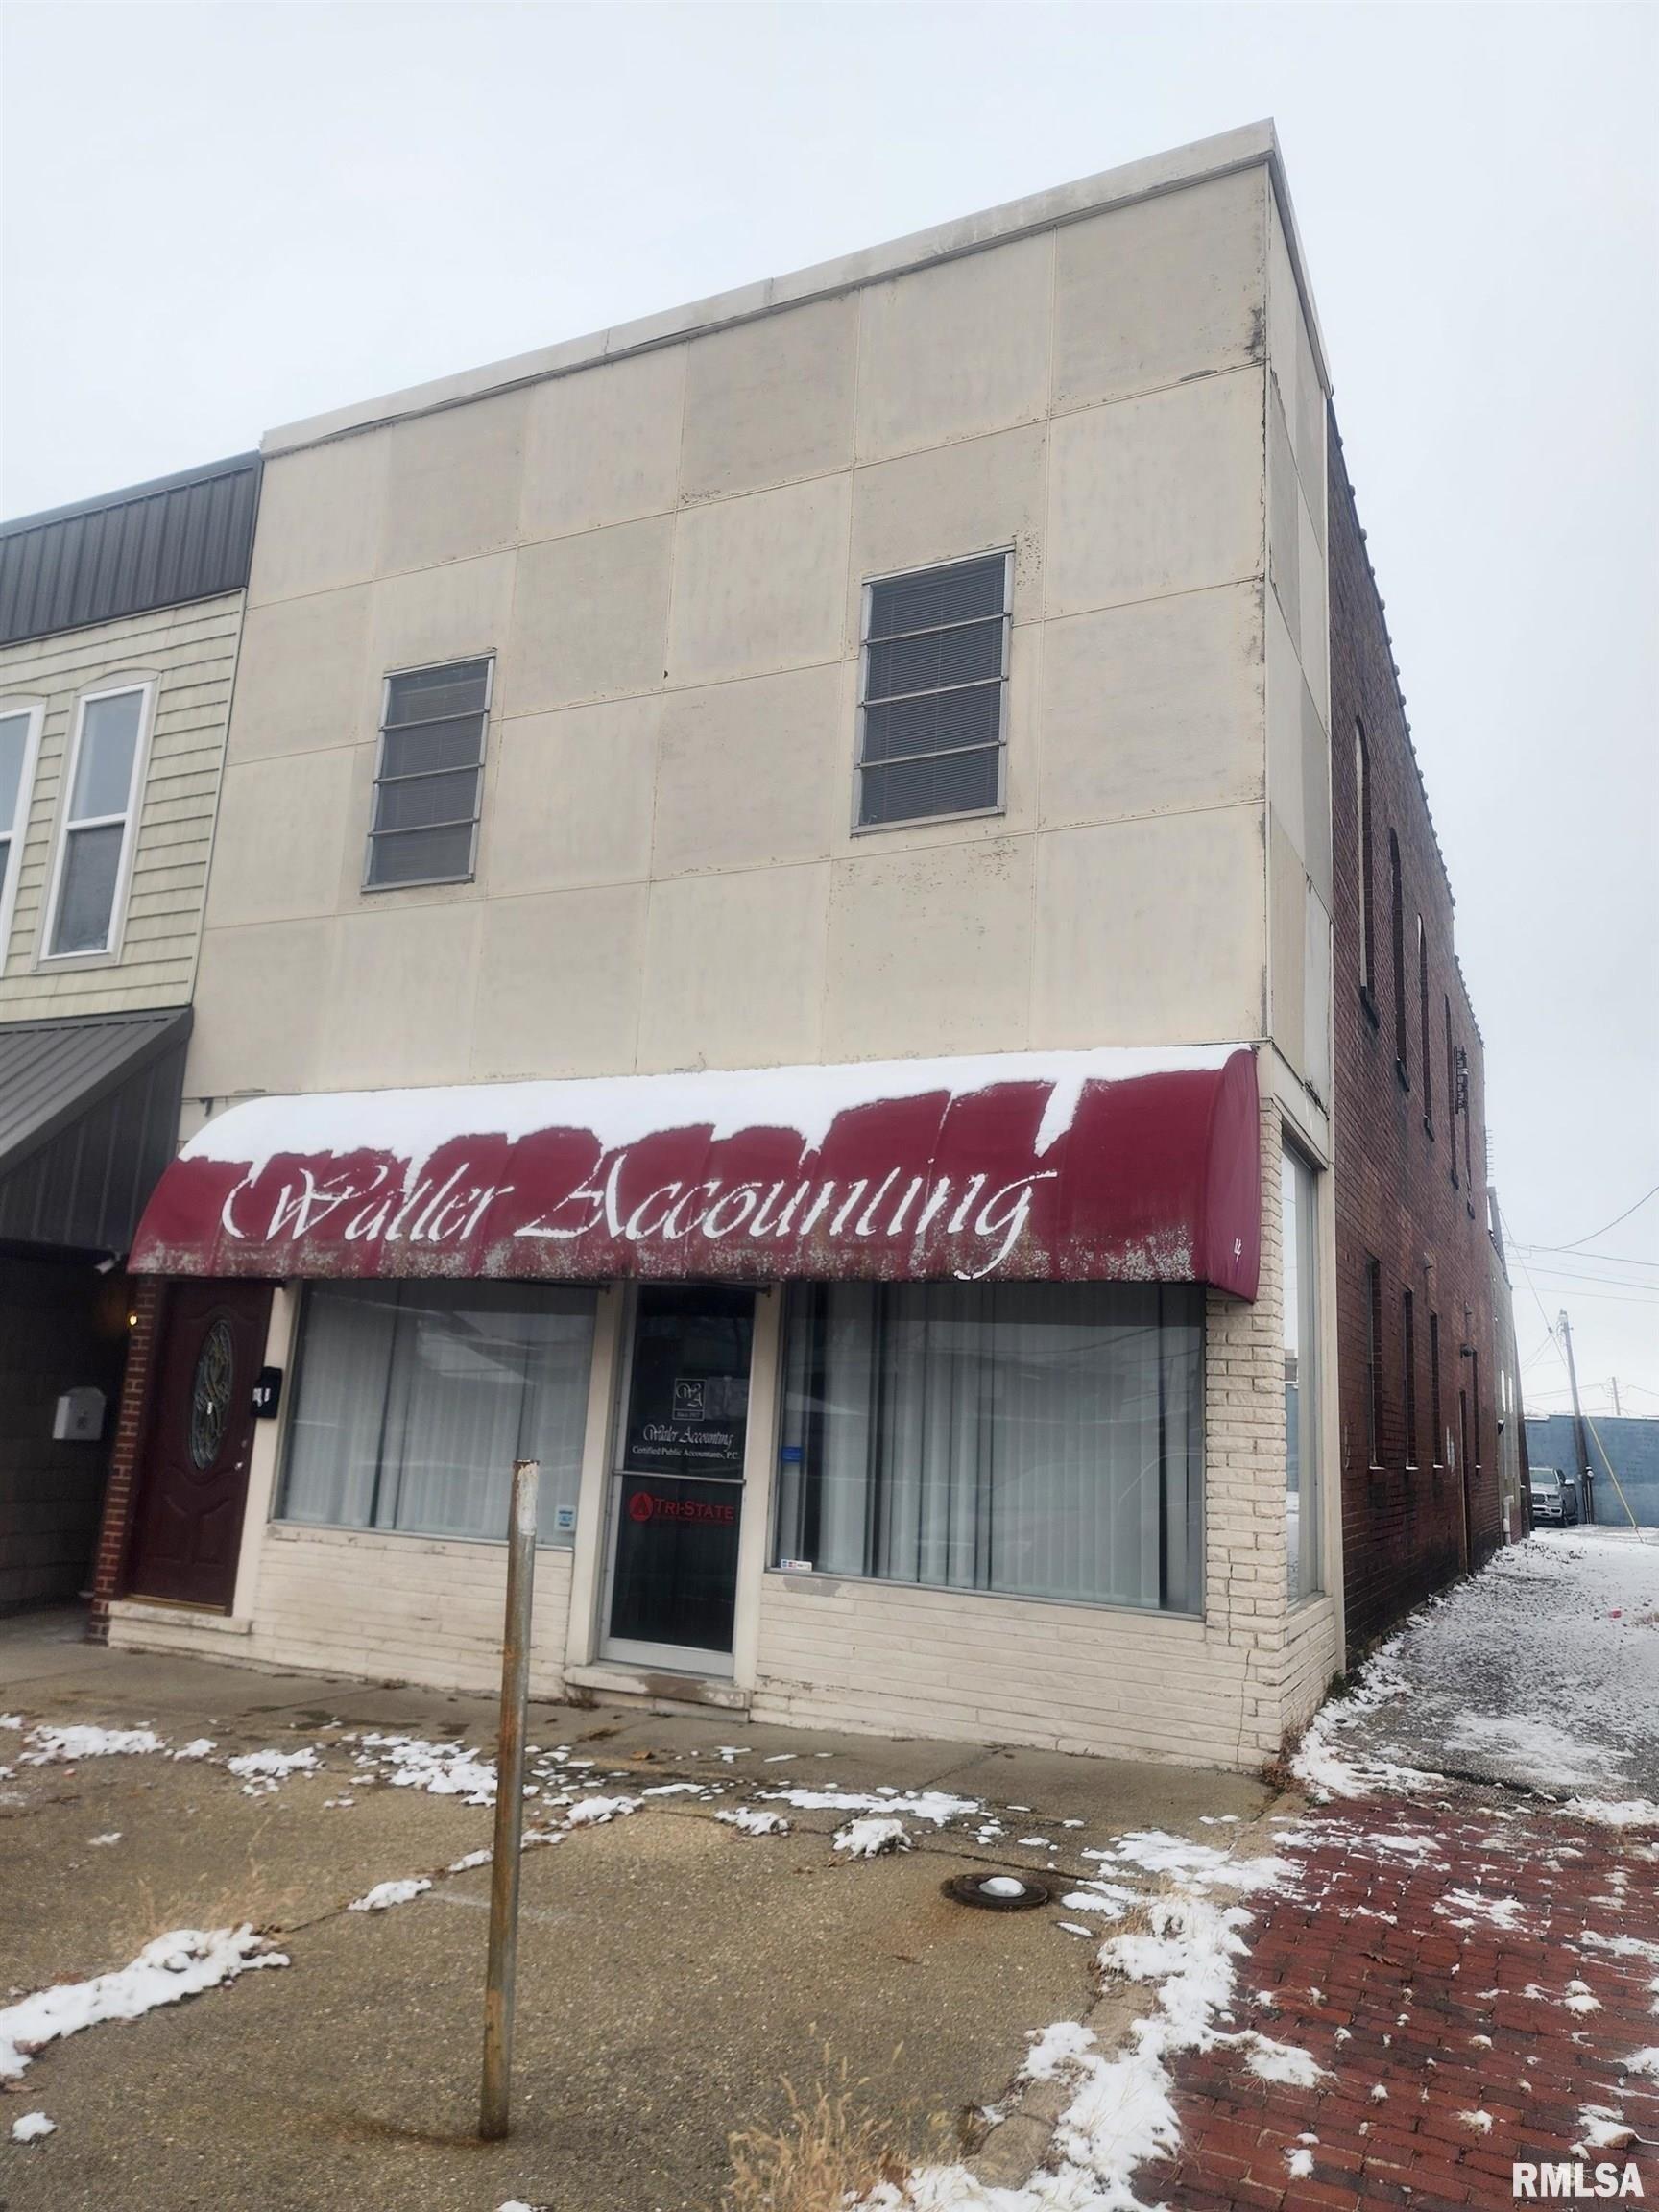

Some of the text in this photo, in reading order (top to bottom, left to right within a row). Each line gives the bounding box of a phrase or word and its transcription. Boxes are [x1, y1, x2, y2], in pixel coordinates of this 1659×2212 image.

[221, 1153, 1058, 1281] Waller Accounting
[632, 1445, 661, 1455] Certified
[661, 1447, 682, 1456] Public
[654, 1499, 733, 1520] TRI-STATE
